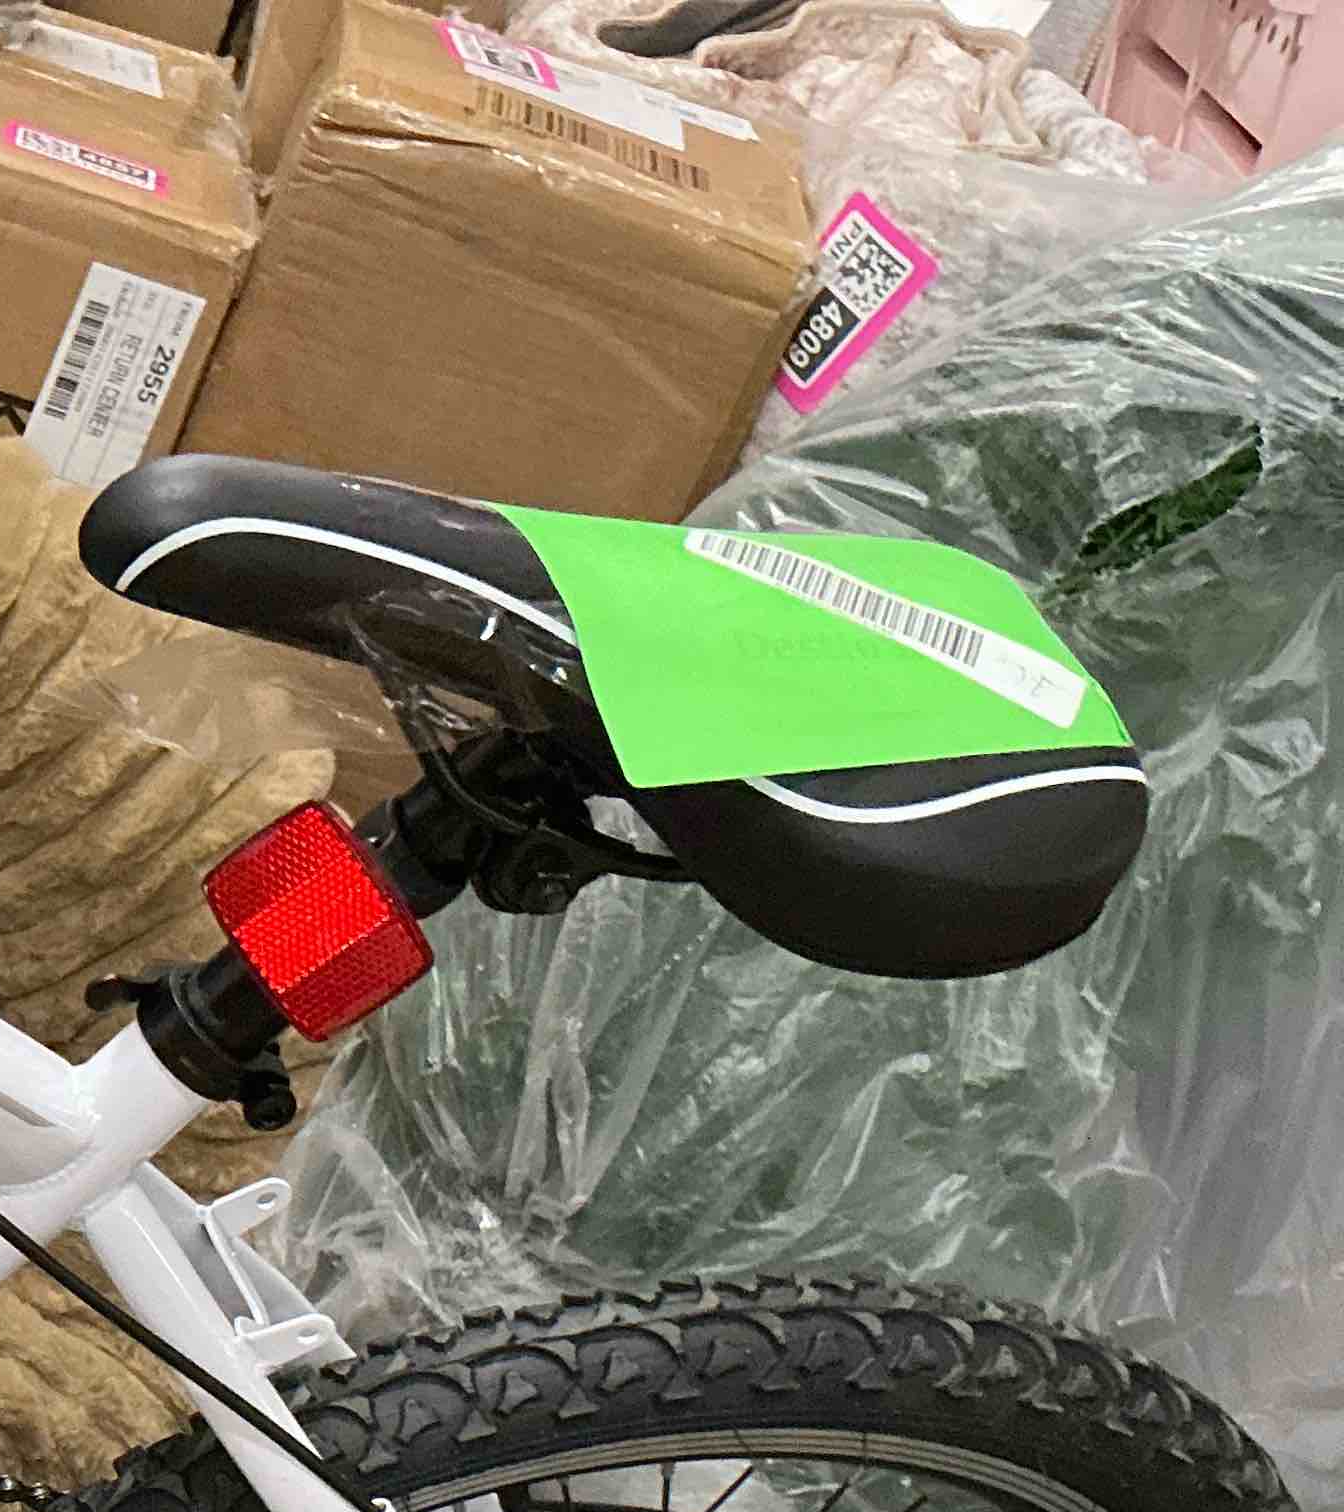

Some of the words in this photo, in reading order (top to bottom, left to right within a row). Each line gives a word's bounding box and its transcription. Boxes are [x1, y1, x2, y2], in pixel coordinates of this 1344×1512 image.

[109, 334, 143, 386] RETURN
[789, 300, 844, 369] 4809
[138, 344, 175, 406] 2955
[86, 383, 121, 438] CENTER
